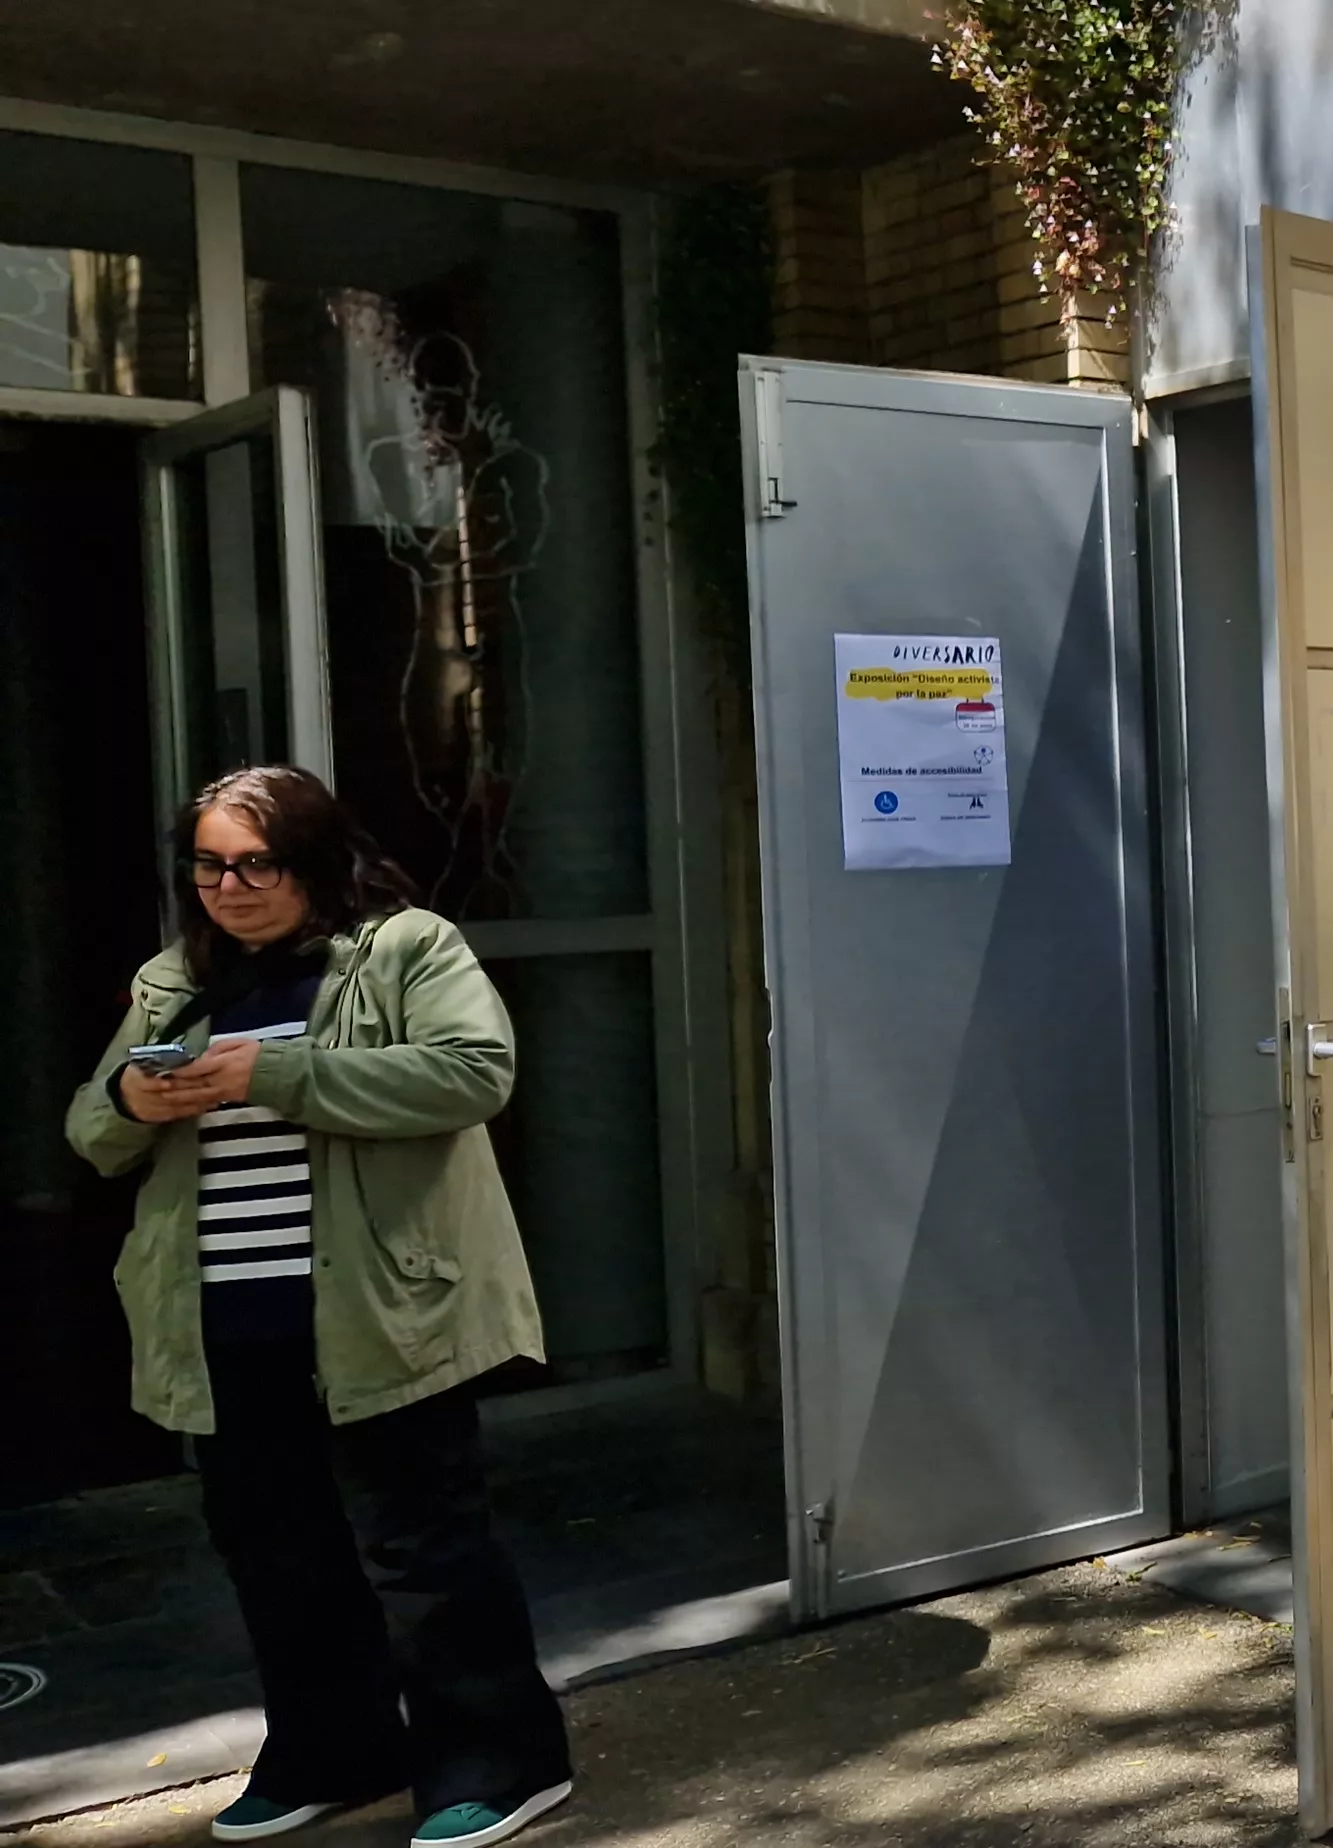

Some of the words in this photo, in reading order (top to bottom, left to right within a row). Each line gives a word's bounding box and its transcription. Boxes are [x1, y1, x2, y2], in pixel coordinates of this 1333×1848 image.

[893, 644, 995, 665] DIVERSARIO
[850, 672, 910, 684] Exposición
[957, 674, 1000, 684] activista
[896, 690, 913, 700] por
[916, 688, 926, 698] la
[861, 766, 903, 776] Medidas
[905, 766, 916, 776] de
[920, 766, 983, 776] accesibilidad
